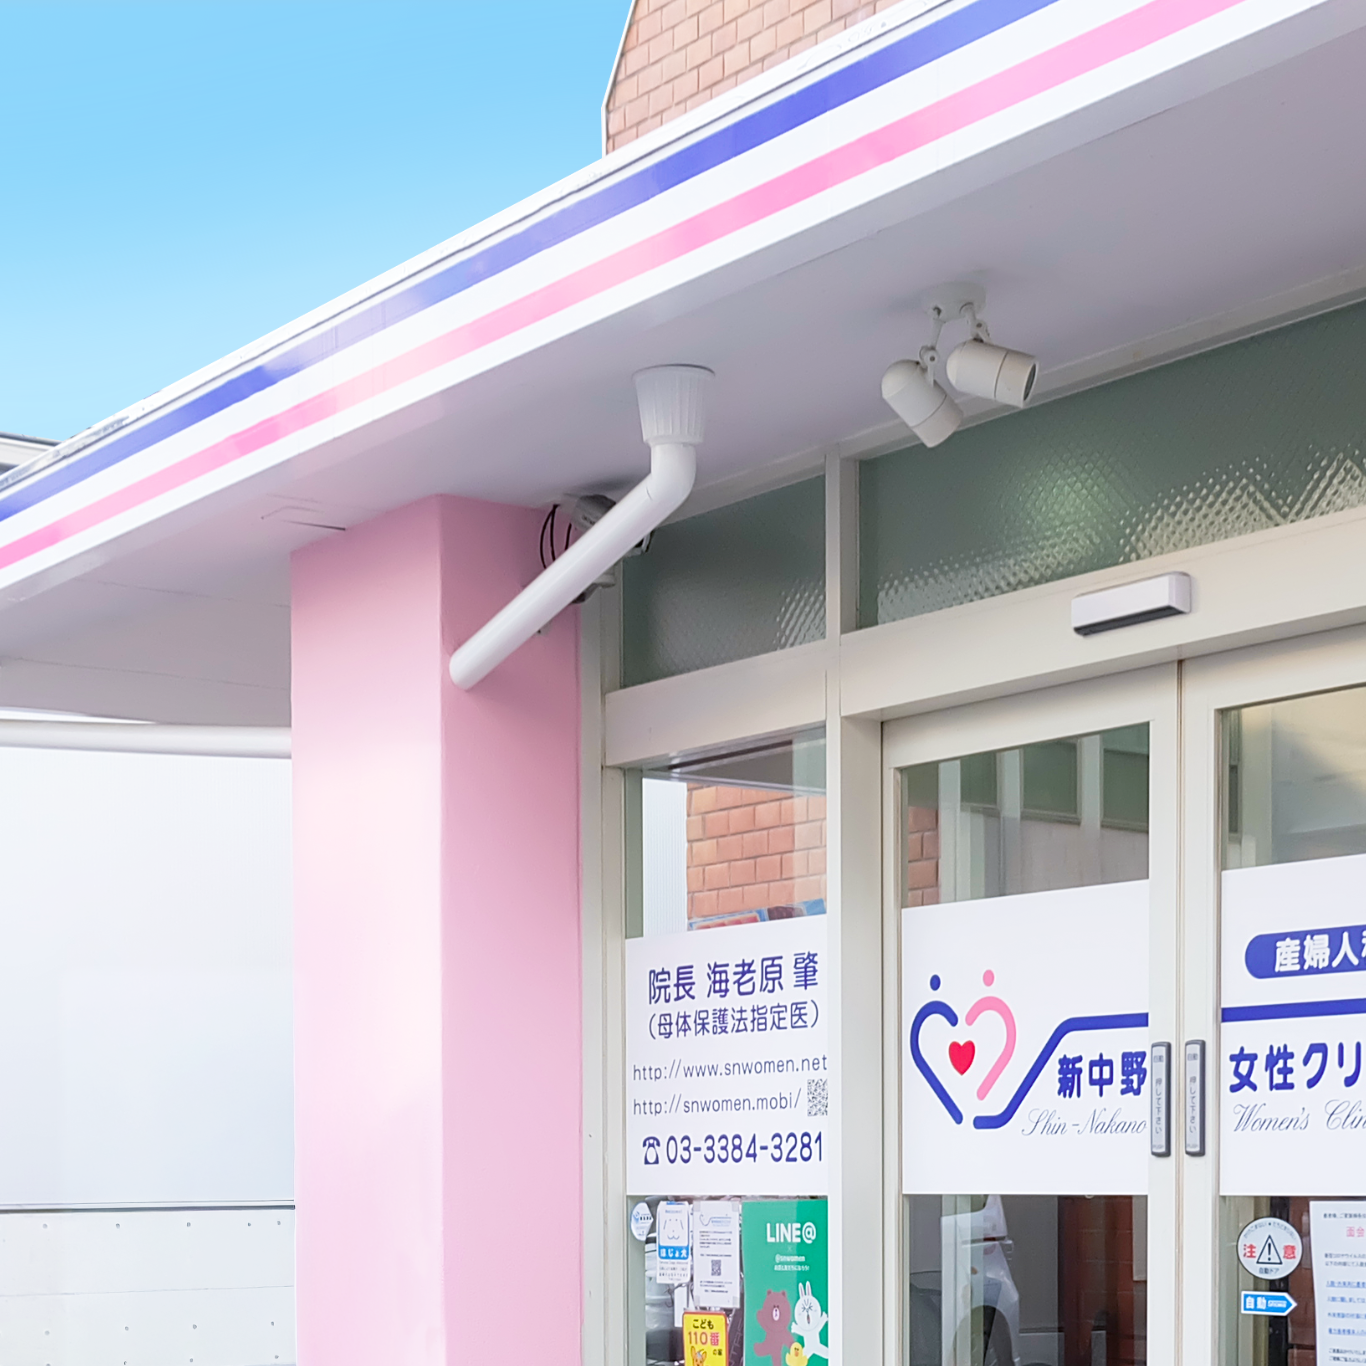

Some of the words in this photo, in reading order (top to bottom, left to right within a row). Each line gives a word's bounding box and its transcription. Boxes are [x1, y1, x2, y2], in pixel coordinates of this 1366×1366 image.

[649, 965, 694, 1003] 院長
[706, 955, 782, 996] 海老原
[793, 951, 817, 988] 肇
[649, 999, 817, 1038] (母体保護法指定医)
[633, 1054, 826, 1080] http://www.snwomen.net
[1057, 1051, 1145, 1096] 新中野
[633, 1087, 799, 1115] http://snwomen.mobi/
[1233, 1102, 1308, 1130] Women's
[666, 1131, 821, 1162] 03-3384-3281
[766, 1221, 815, 1242] LINE@
[1246, 1296, 1265, 1308] 自動
[688, 1331, 717, 1344] 110番
[693, 1319, 713, 1329] こども
